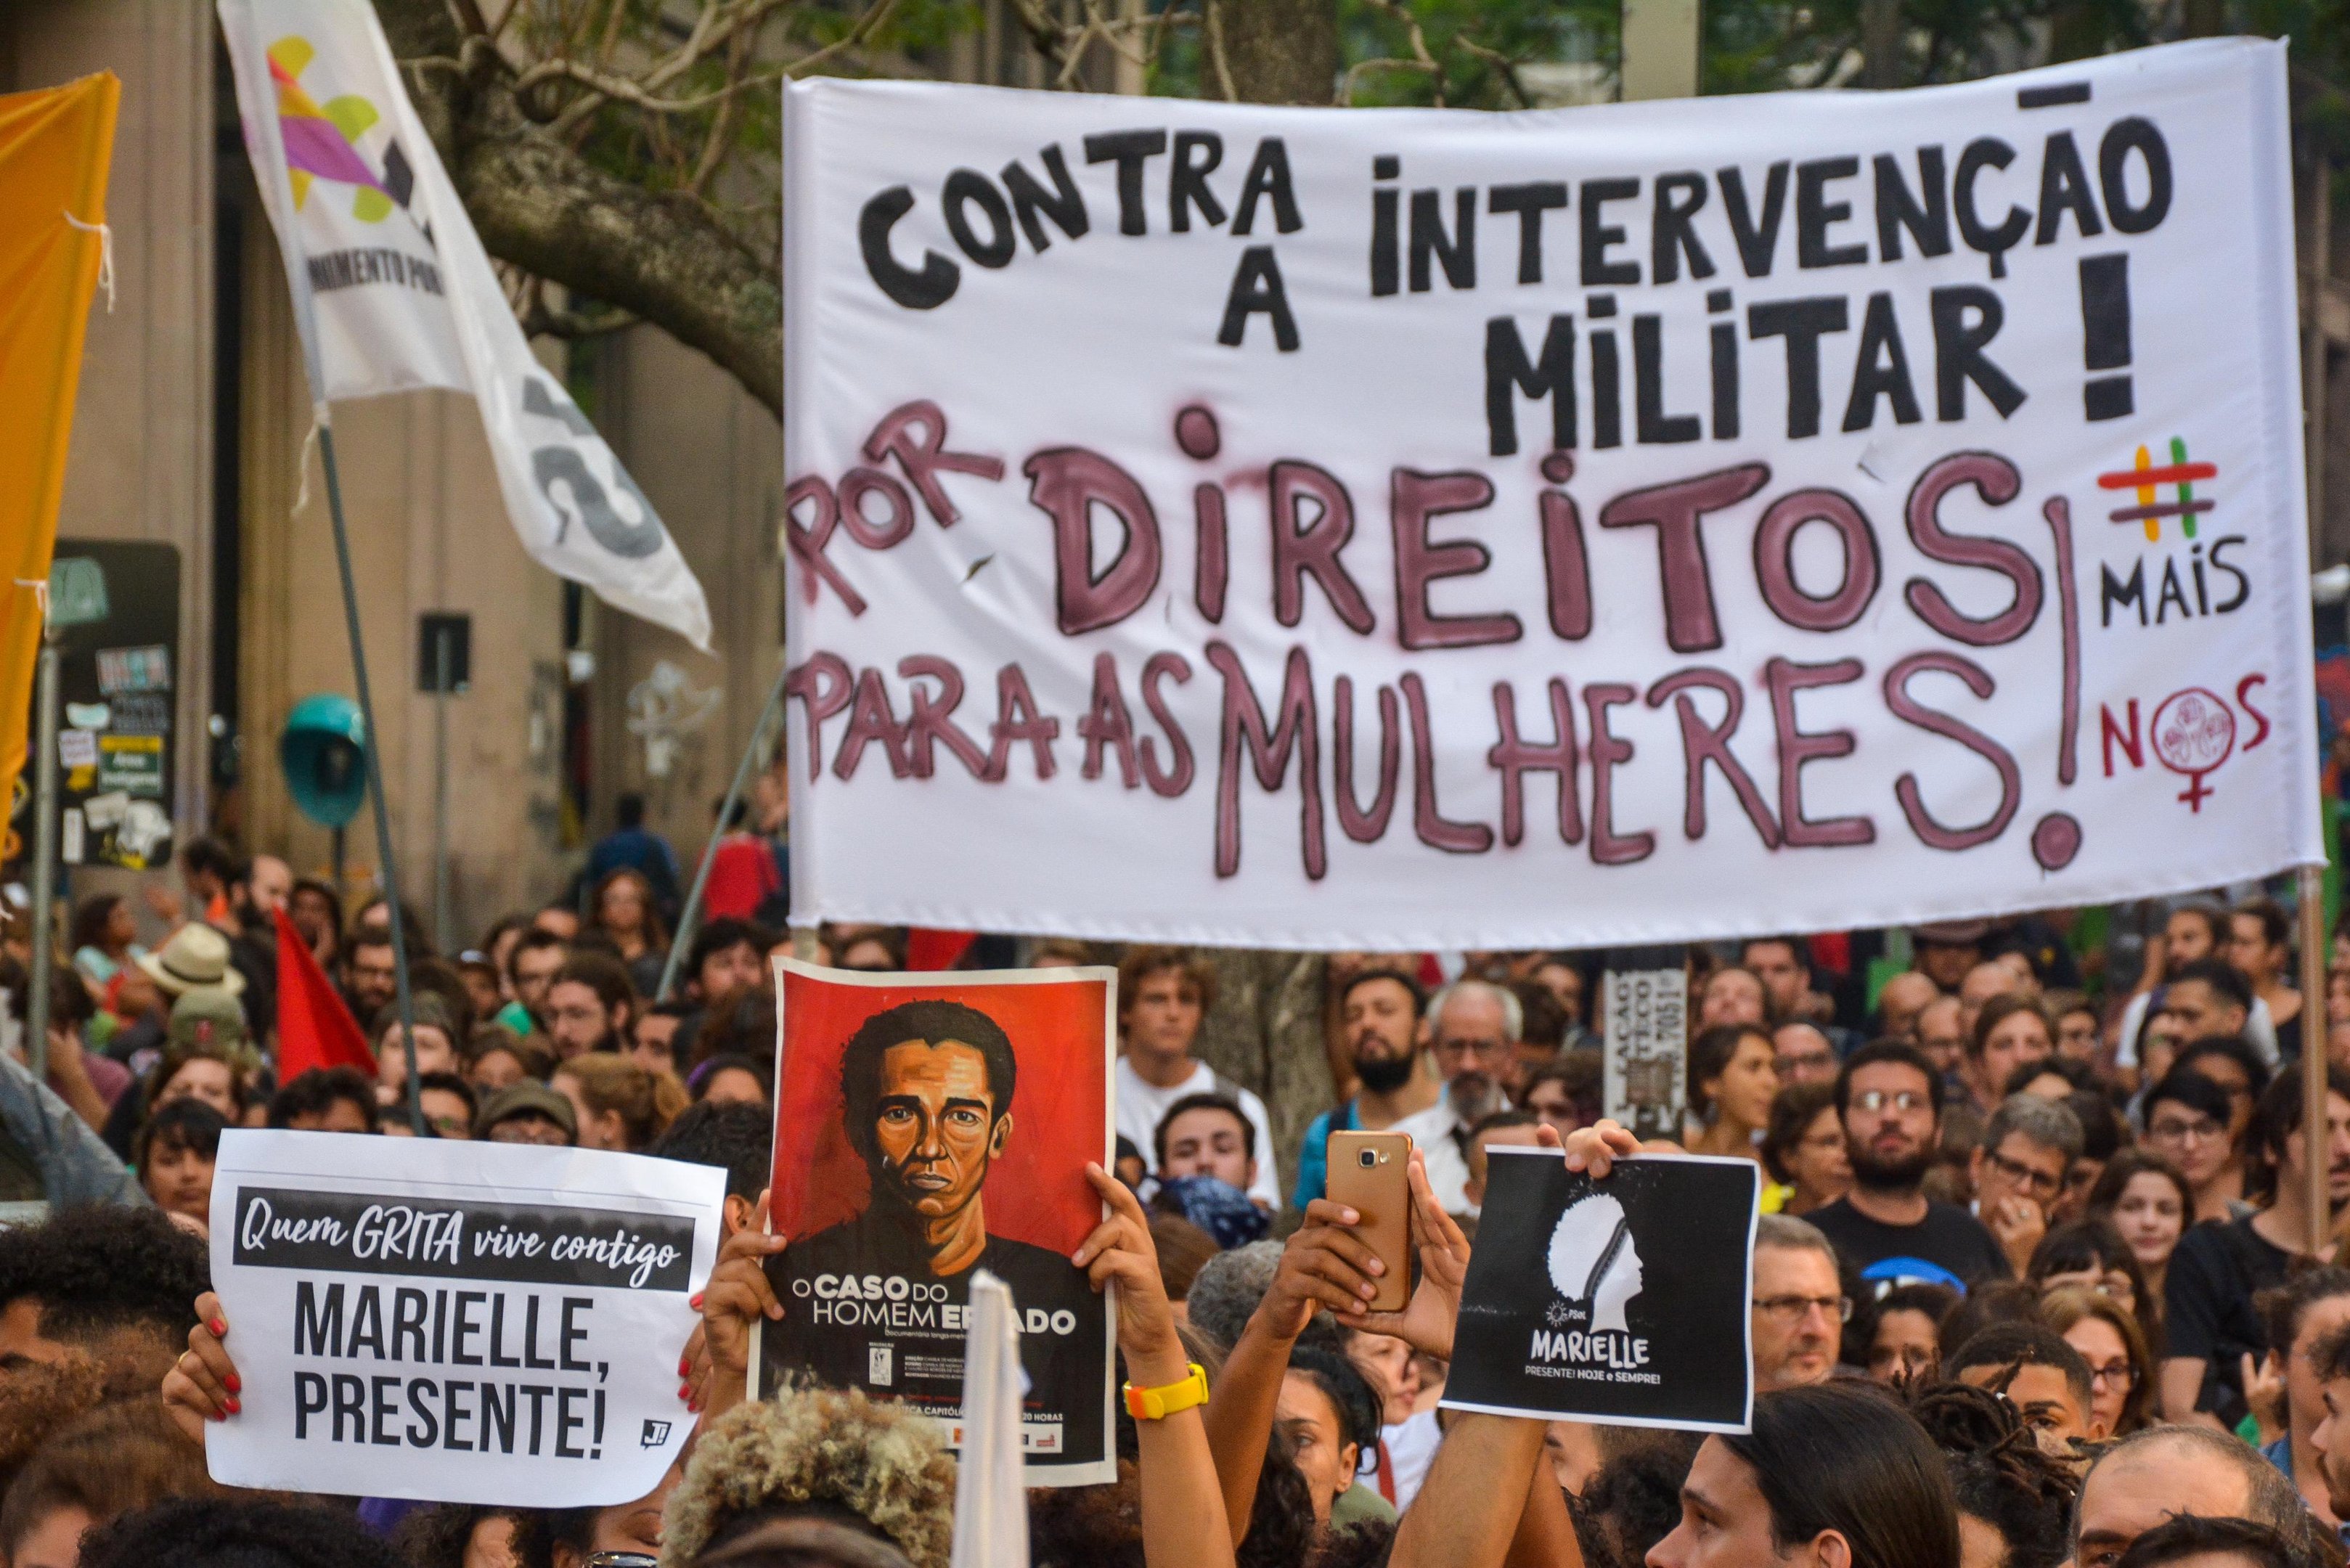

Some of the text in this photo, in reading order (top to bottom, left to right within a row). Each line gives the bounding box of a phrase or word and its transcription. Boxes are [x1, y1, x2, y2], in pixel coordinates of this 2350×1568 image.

[858, 126, 1303, 310] CONTRA
[1217, 245, 1300, 353] A
[786, 399, 1005, 617] POR
[786, 650, 1058, 785] PARA
[1079, 651, 1194, 799] AS
[242, 1197, 681, 1288] Quem GRITA vive contigo
[792, 1274, 949, 1303] O CASO DO
[293, 1281, 609, 1383] MARIELLE,
[813, 1300, 935, 1328] HOMEM
[1530, 1329, 1650, 1369] MARIELLE
[295, 1371, 607, 1461] PRESENTE!
